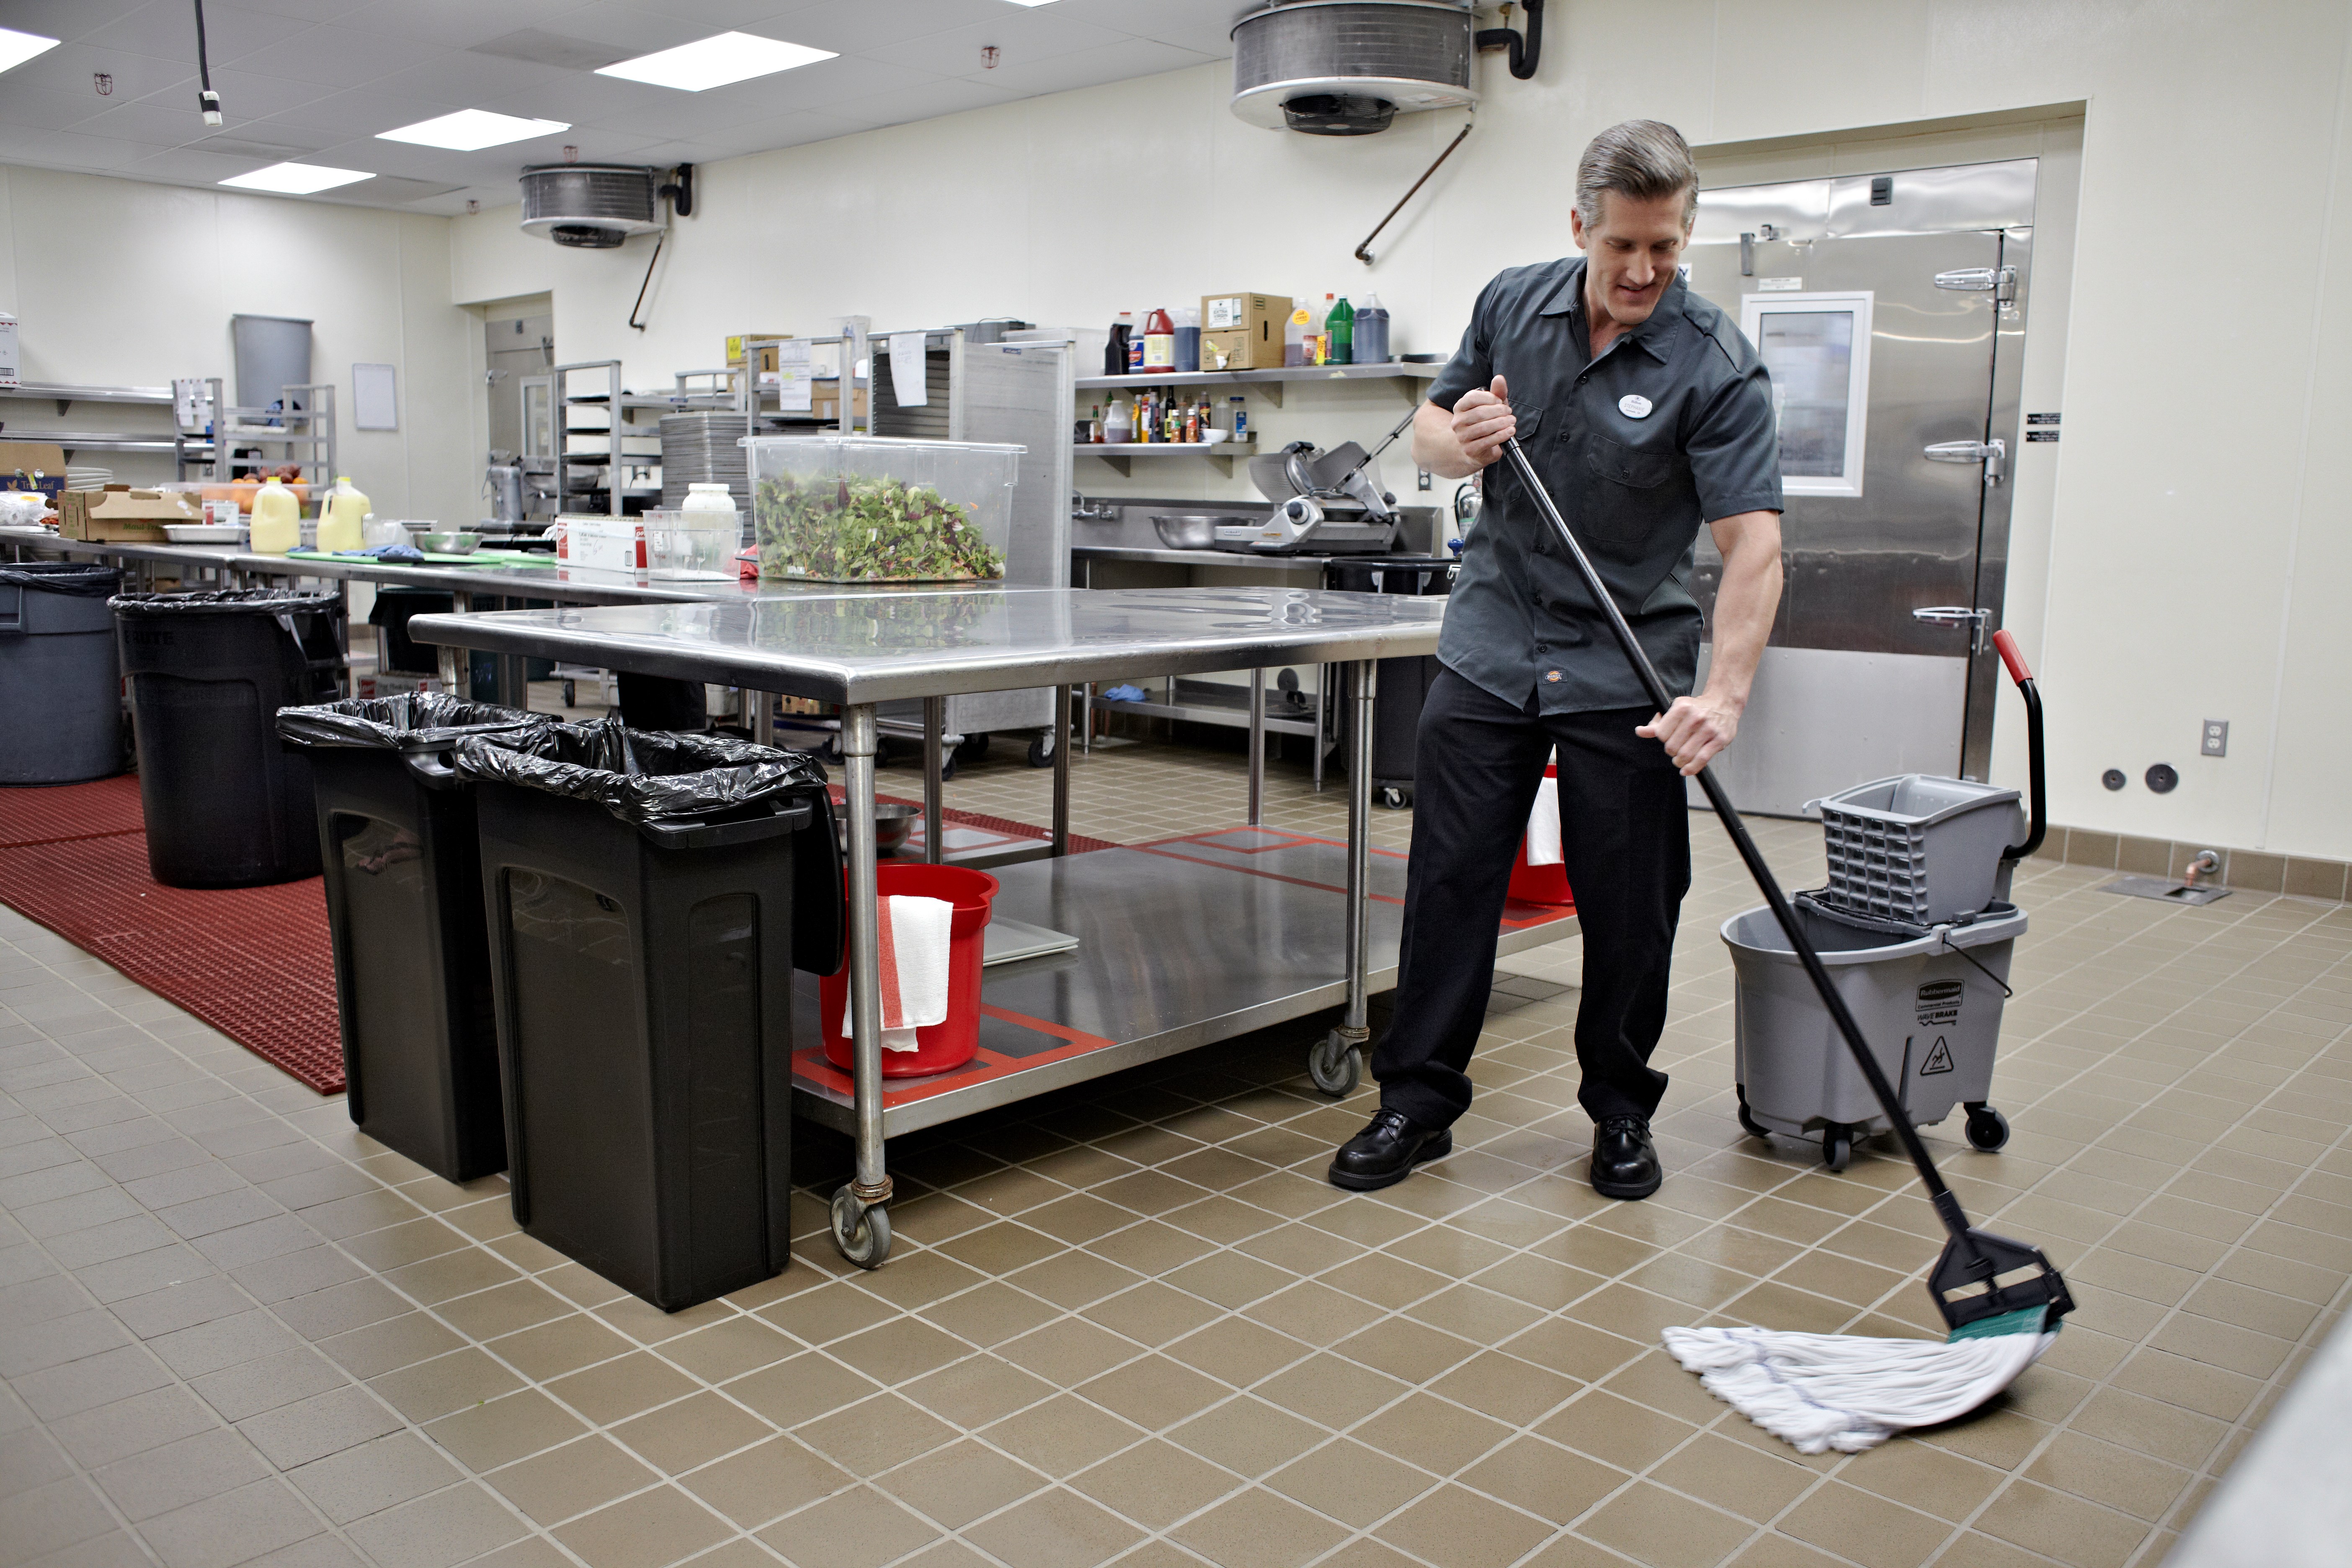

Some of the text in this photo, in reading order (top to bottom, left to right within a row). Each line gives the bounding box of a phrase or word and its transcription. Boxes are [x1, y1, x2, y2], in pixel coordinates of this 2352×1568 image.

[1624, 403, 1645, 412] STEPHANIE
[39, 481, 54, 490] Leaf
[1920, 985, 1961, 997] Rubbermaid
